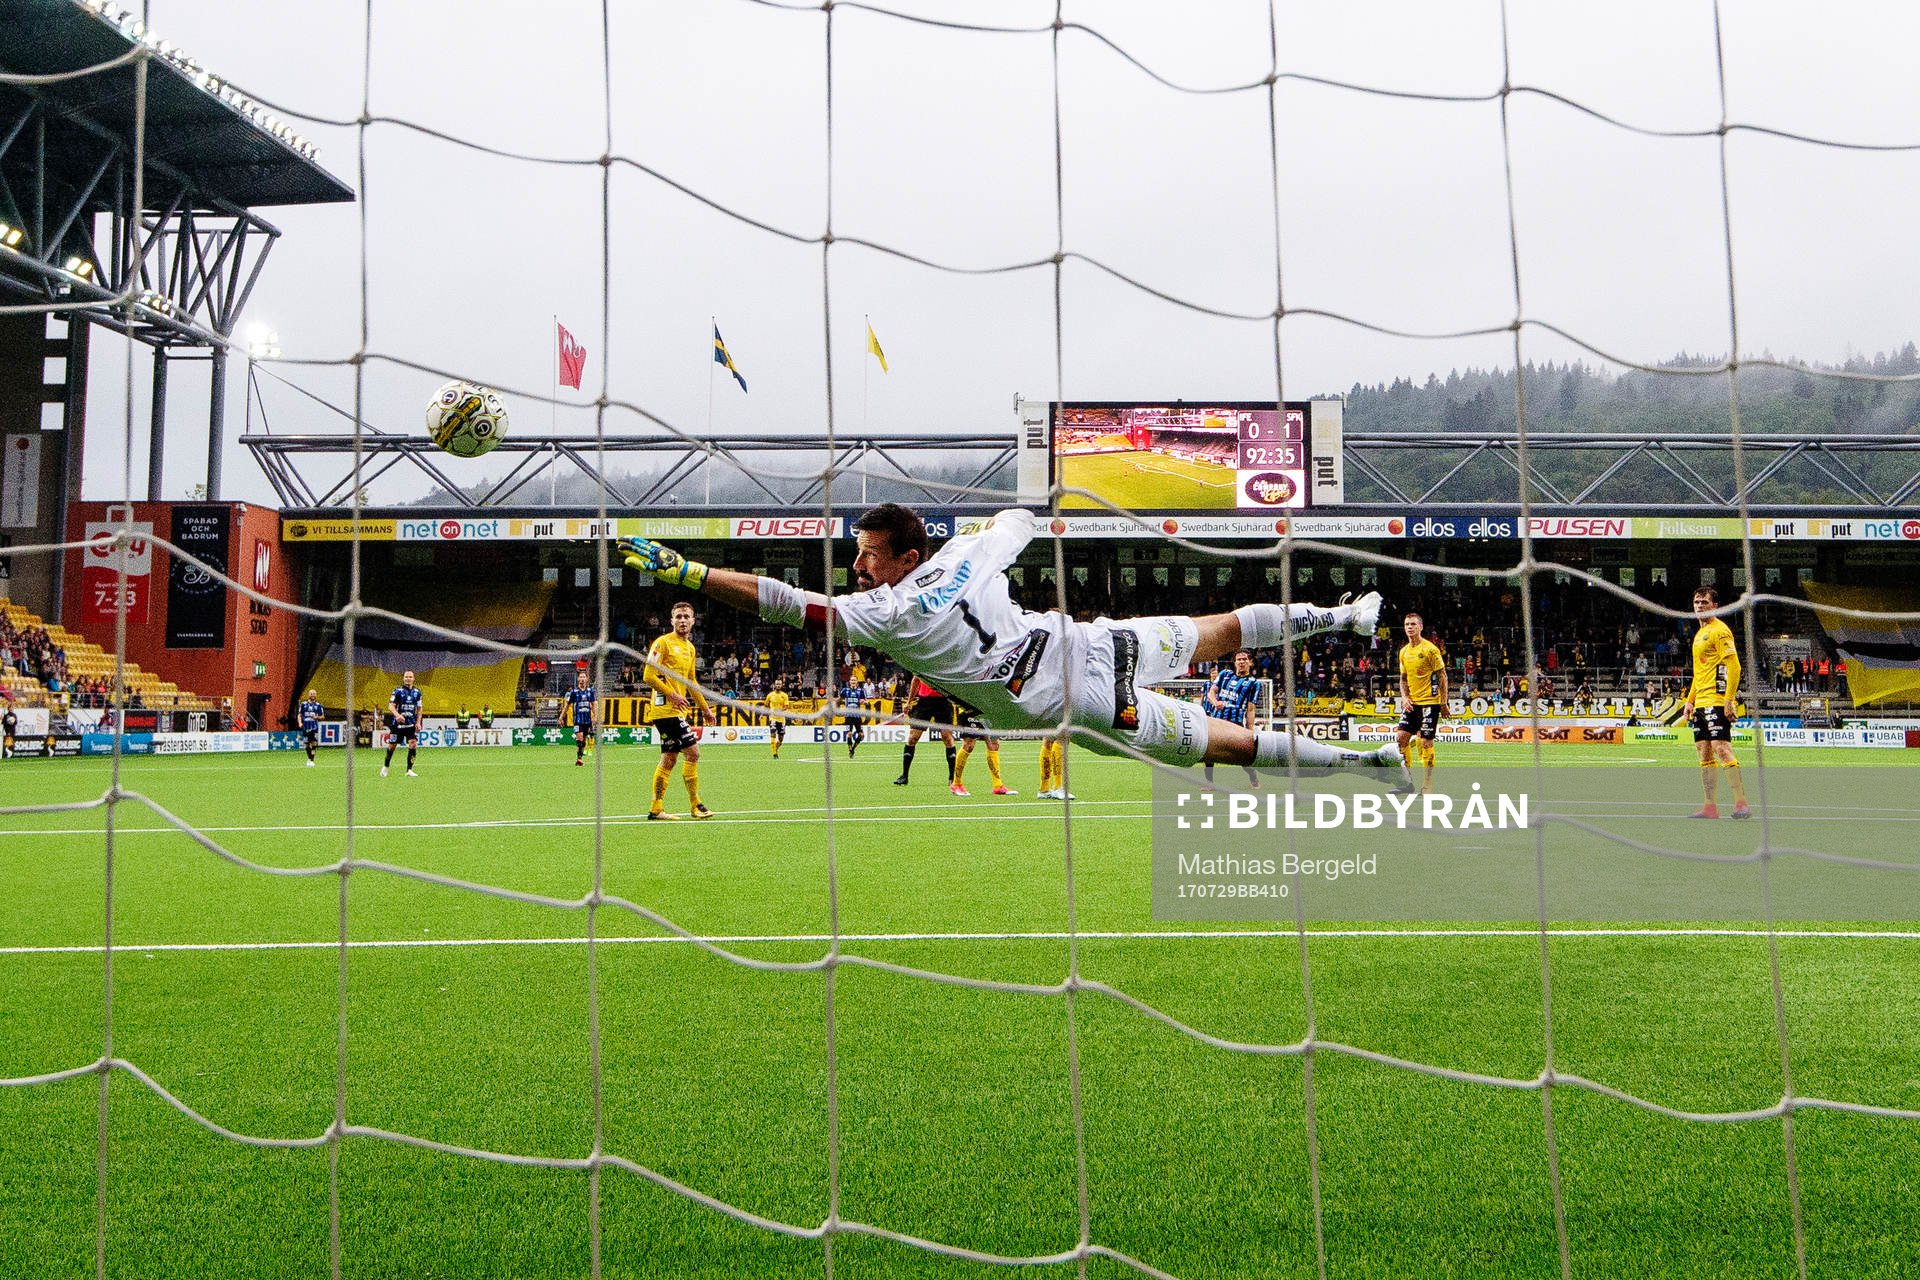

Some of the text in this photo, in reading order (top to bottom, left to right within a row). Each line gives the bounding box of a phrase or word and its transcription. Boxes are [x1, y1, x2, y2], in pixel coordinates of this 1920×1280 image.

[1248, 422, 1260, 438] 0
[1283, 422, 1291, 439] 1
[1246, 447, 1295, 465] 92:35
[312, 526, 322, 534] VI
[325, 525, 393, 535] TILLSAMMANS
[737, 519, 836, 537] PULSEN
[1069, 522, 1117, 532] Swedbank
[1181, 522, 1230, 532] Swedbank
[1294, 522, 1342, 532] Swedbank
[1413, 517, 1455, 537] ellos
[1468, 517, 1511, 537] ellos
[1527, 519, 1625, 536] PULSEN
[951, 598, 998, 655] 1
[460, 731, 503, 746] ELIT
[1778, 731, 1806, 740] UBAB
[1826, 732, 1855, 740] UBAB
[1876, 732, 1904, 740] UBAB
